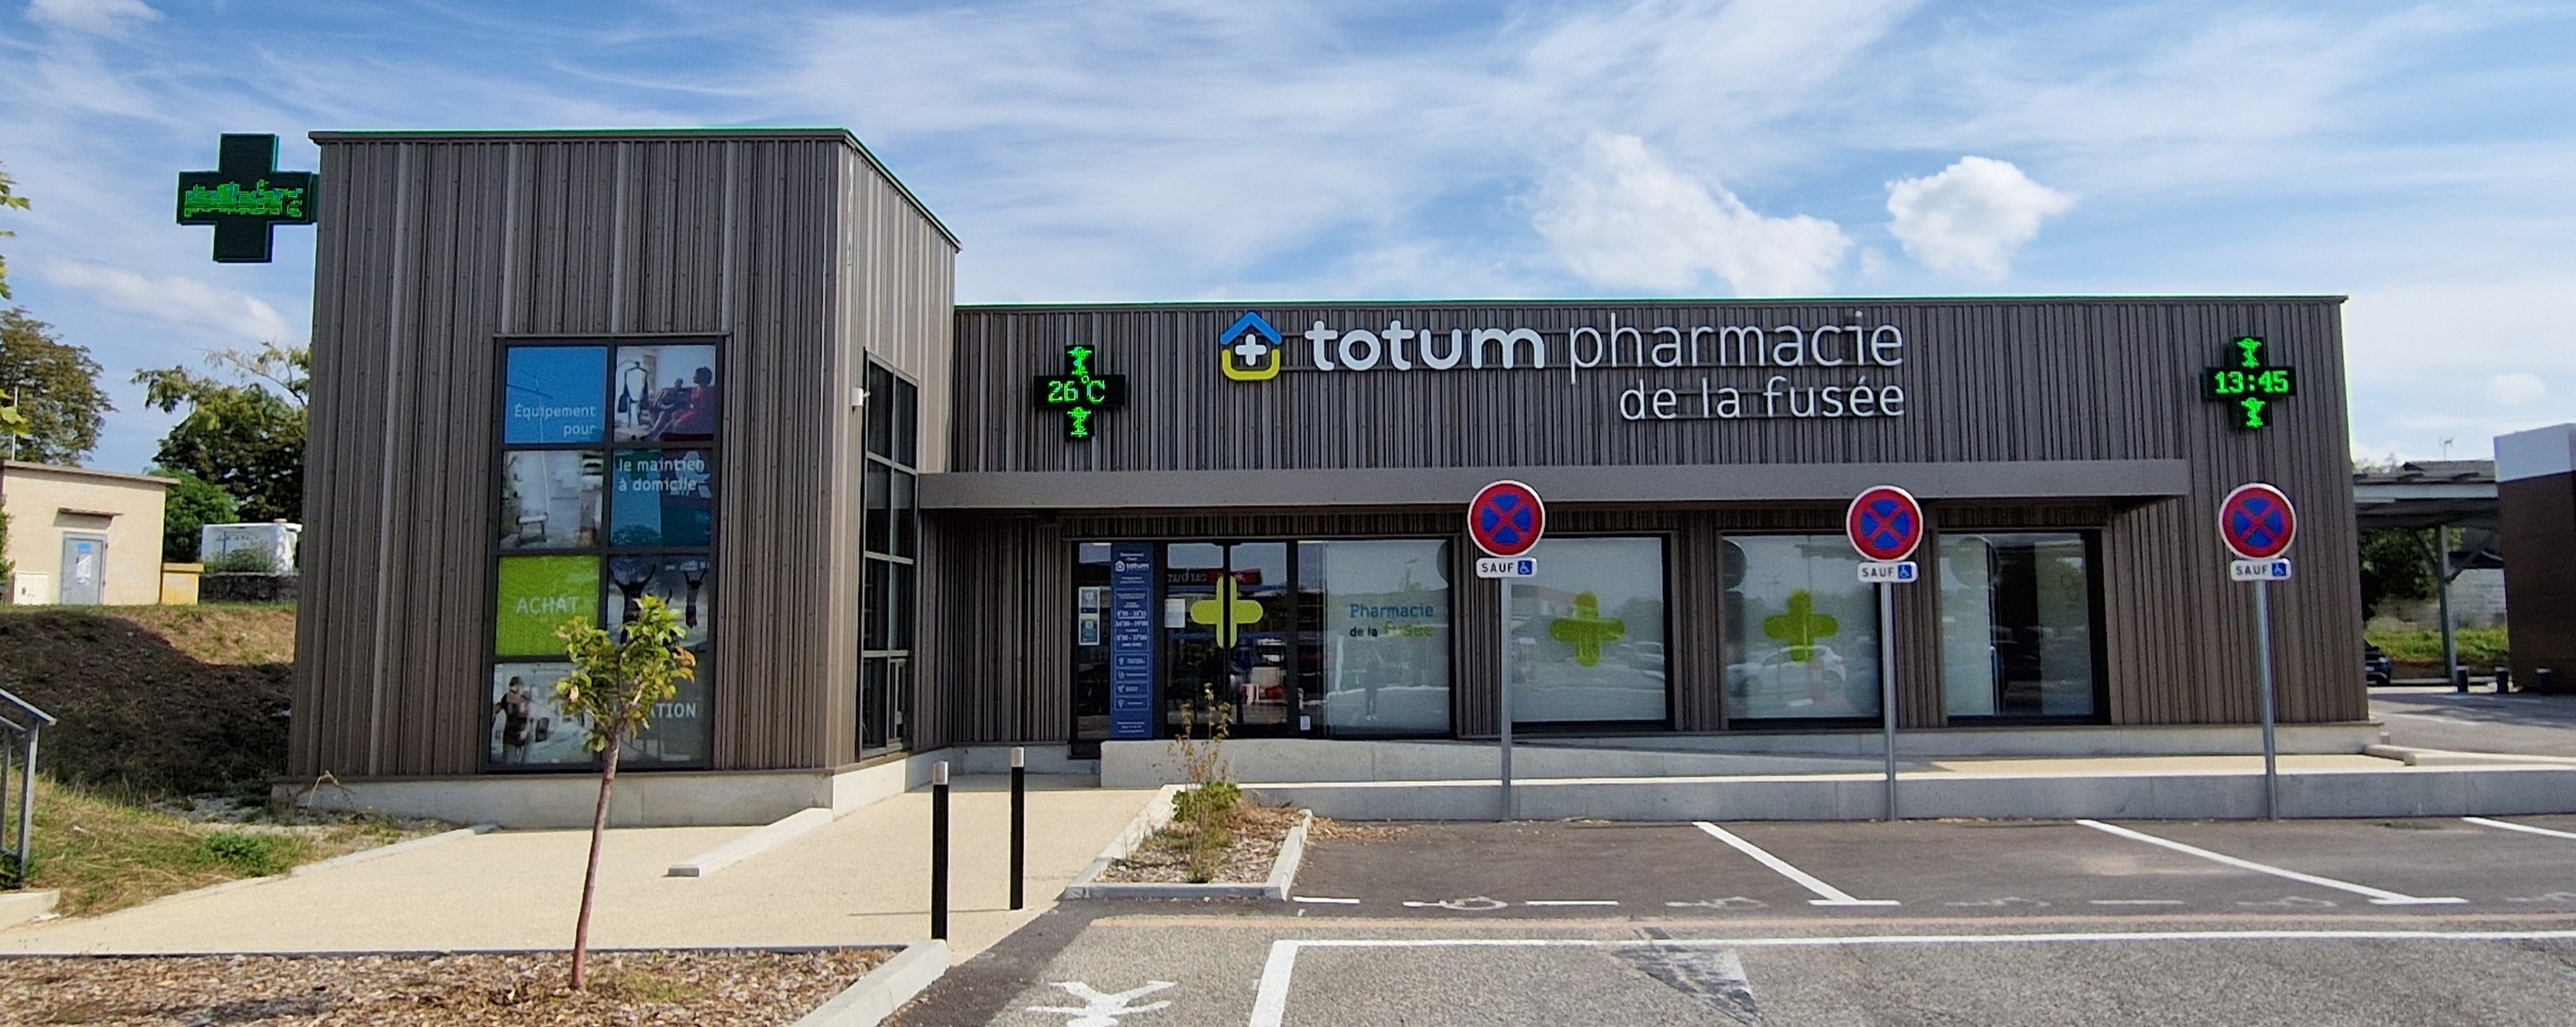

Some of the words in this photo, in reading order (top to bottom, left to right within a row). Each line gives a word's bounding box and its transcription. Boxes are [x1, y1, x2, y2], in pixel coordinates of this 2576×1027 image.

[1305, 320, 1545, 371] totum
[1569, 310, 1903, 385] pharmacie
[2214, 370, 2288, 393] 13:45
[1619, 378, 1677, 420] de
[1702, 377, 1741, 419] la
[1762, 375, 1905, 417] fusée
[514, 403, 597, 420] Équipement
[563, 424, 596, 437] pour
[619, 459, 632, 471] le
[637, 458, 706, 472] maintien
[619, 478, 627, 491] à
[632, 477, 697, 491] domicile
[1481, 562, 1514, 573] SAUF
[1862, 567, 1894, 577] SAUF
[2235, 564, 2268, 576] SAUF
[516, 595, 580, 614] ACHAT
[1350, 603, 1433, 618] Pharmacie
[1349, 626, 1363, 637] de
[1368, 626, 1378, 637] la
